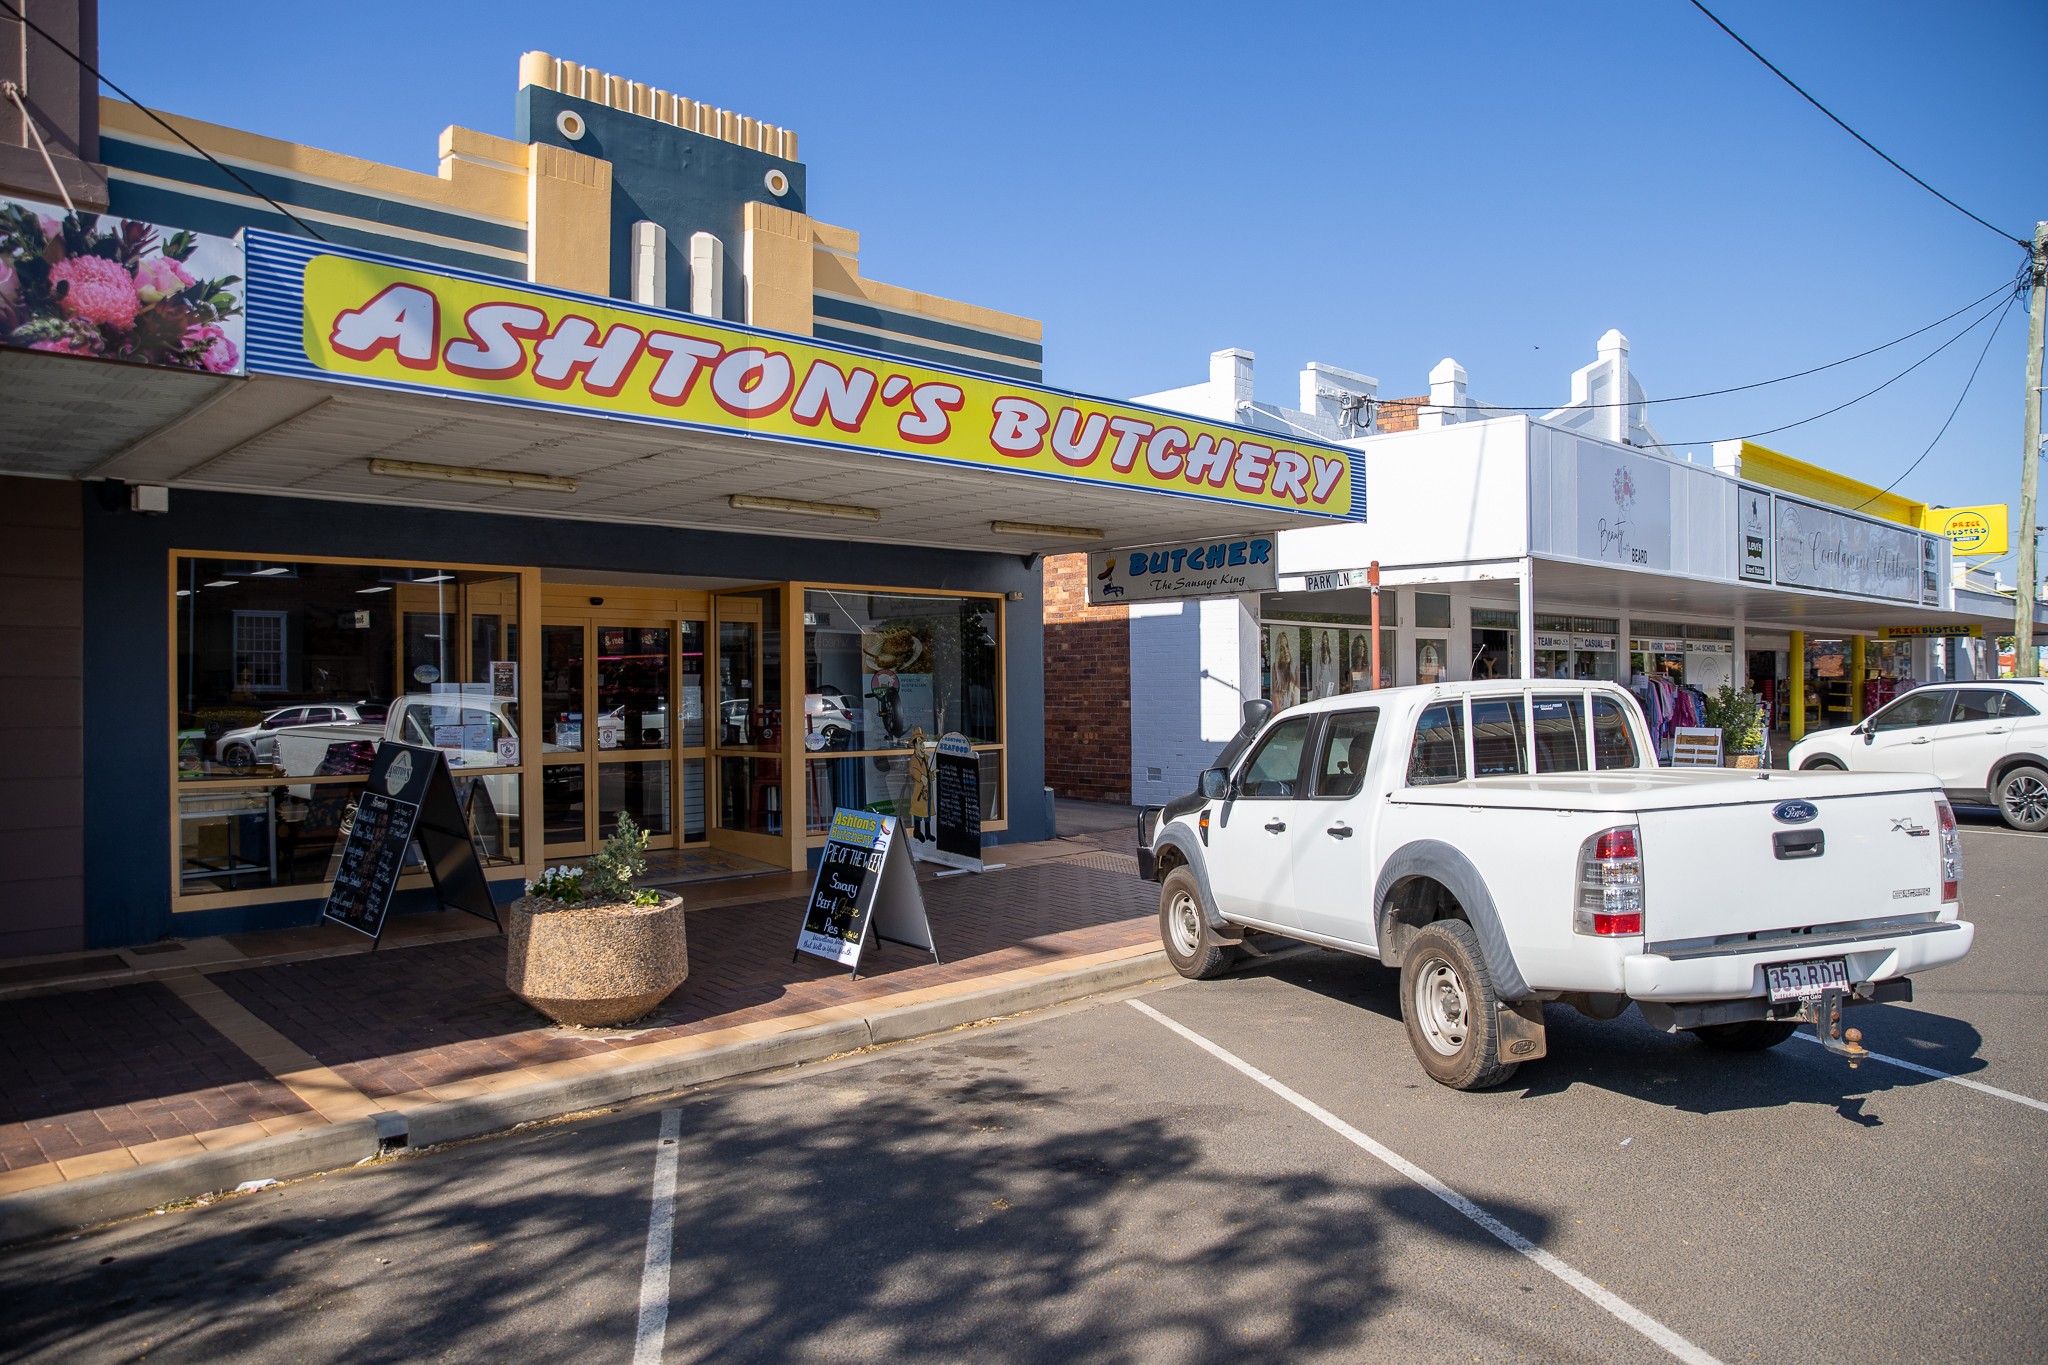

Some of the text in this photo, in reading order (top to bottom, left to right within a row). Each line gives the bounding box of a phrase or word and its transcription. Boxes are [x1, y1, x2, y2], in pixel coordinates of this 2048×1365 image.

[328, 281, 1344, 505] ASHTON'S BUTCHERY
[1946, 528, 1987, 536] BUSTERS
[1952, 520, 1981, 529] PRICE
[1128, 538, 1272, 577] BUTCHER
[1631, 547, 1648, 565] BEARD
[1808, 531, 1871, 572] Condamine
[1149, 572, 1246, 592] The Sausage King
[1308, 573, 1332, 591] PARK
[1337, 572, 1350, 588] LN
[1888, 625, 1970, 635] PRICE BUSTERS
[1537, 636, 1553, 646] TEAM
[1584, 638, 1604, 648] CASUAL
[1702, 644, 1717, 653] SCHOOL
[939, 743, 969, 753] SEAFOOD
[834, 811, 877, 830] Ashton's
[1784, 805, 1808, 819] Ford
[1890, 817, 1923, 832] XL
[829, 826, 874, 848] Butchery
[825, 843, 884, 873] PIE OF THE WEEK
[824, 917, 838, 934] Pies
